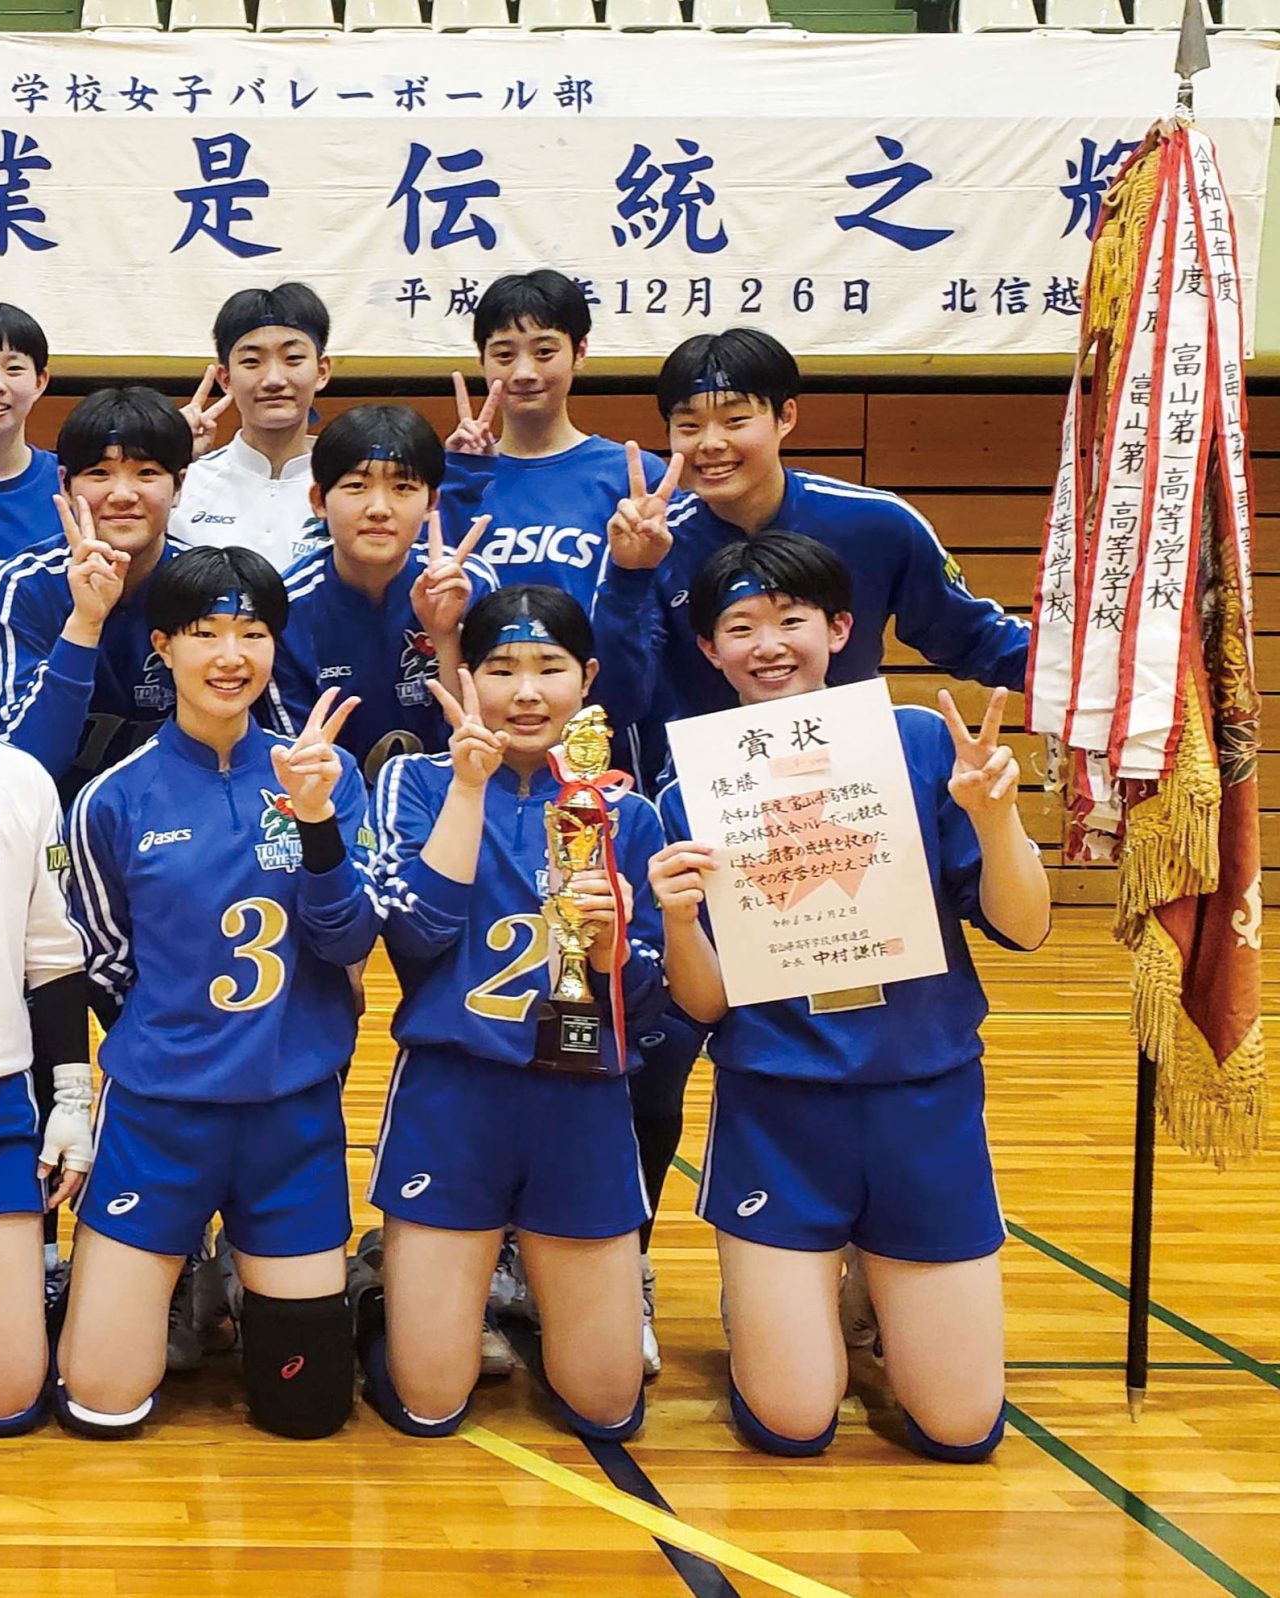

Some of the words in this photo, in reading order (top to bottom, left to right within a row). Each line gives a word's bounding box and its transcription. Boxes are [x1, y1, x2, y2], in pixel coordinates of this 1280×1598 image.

[1194, 143, 1238, 305] 令和五年度
[941, 276, 1082, 316] 北信越
[1145, 342, 1201, 612] 富山第一高等学校
[204, 513, 237, 525] asics
[1089, 372, 1152, 633] 富山第一高等学校
[320, 665, 353, 679] asics
[738, 717, 830, 761] 賞状
[710, 772, 759, 799] 優勝
[154, 828, 192, 845] asics
[209, 896, 289, 1012] 3
[465, 913, 549, 1023] 2
